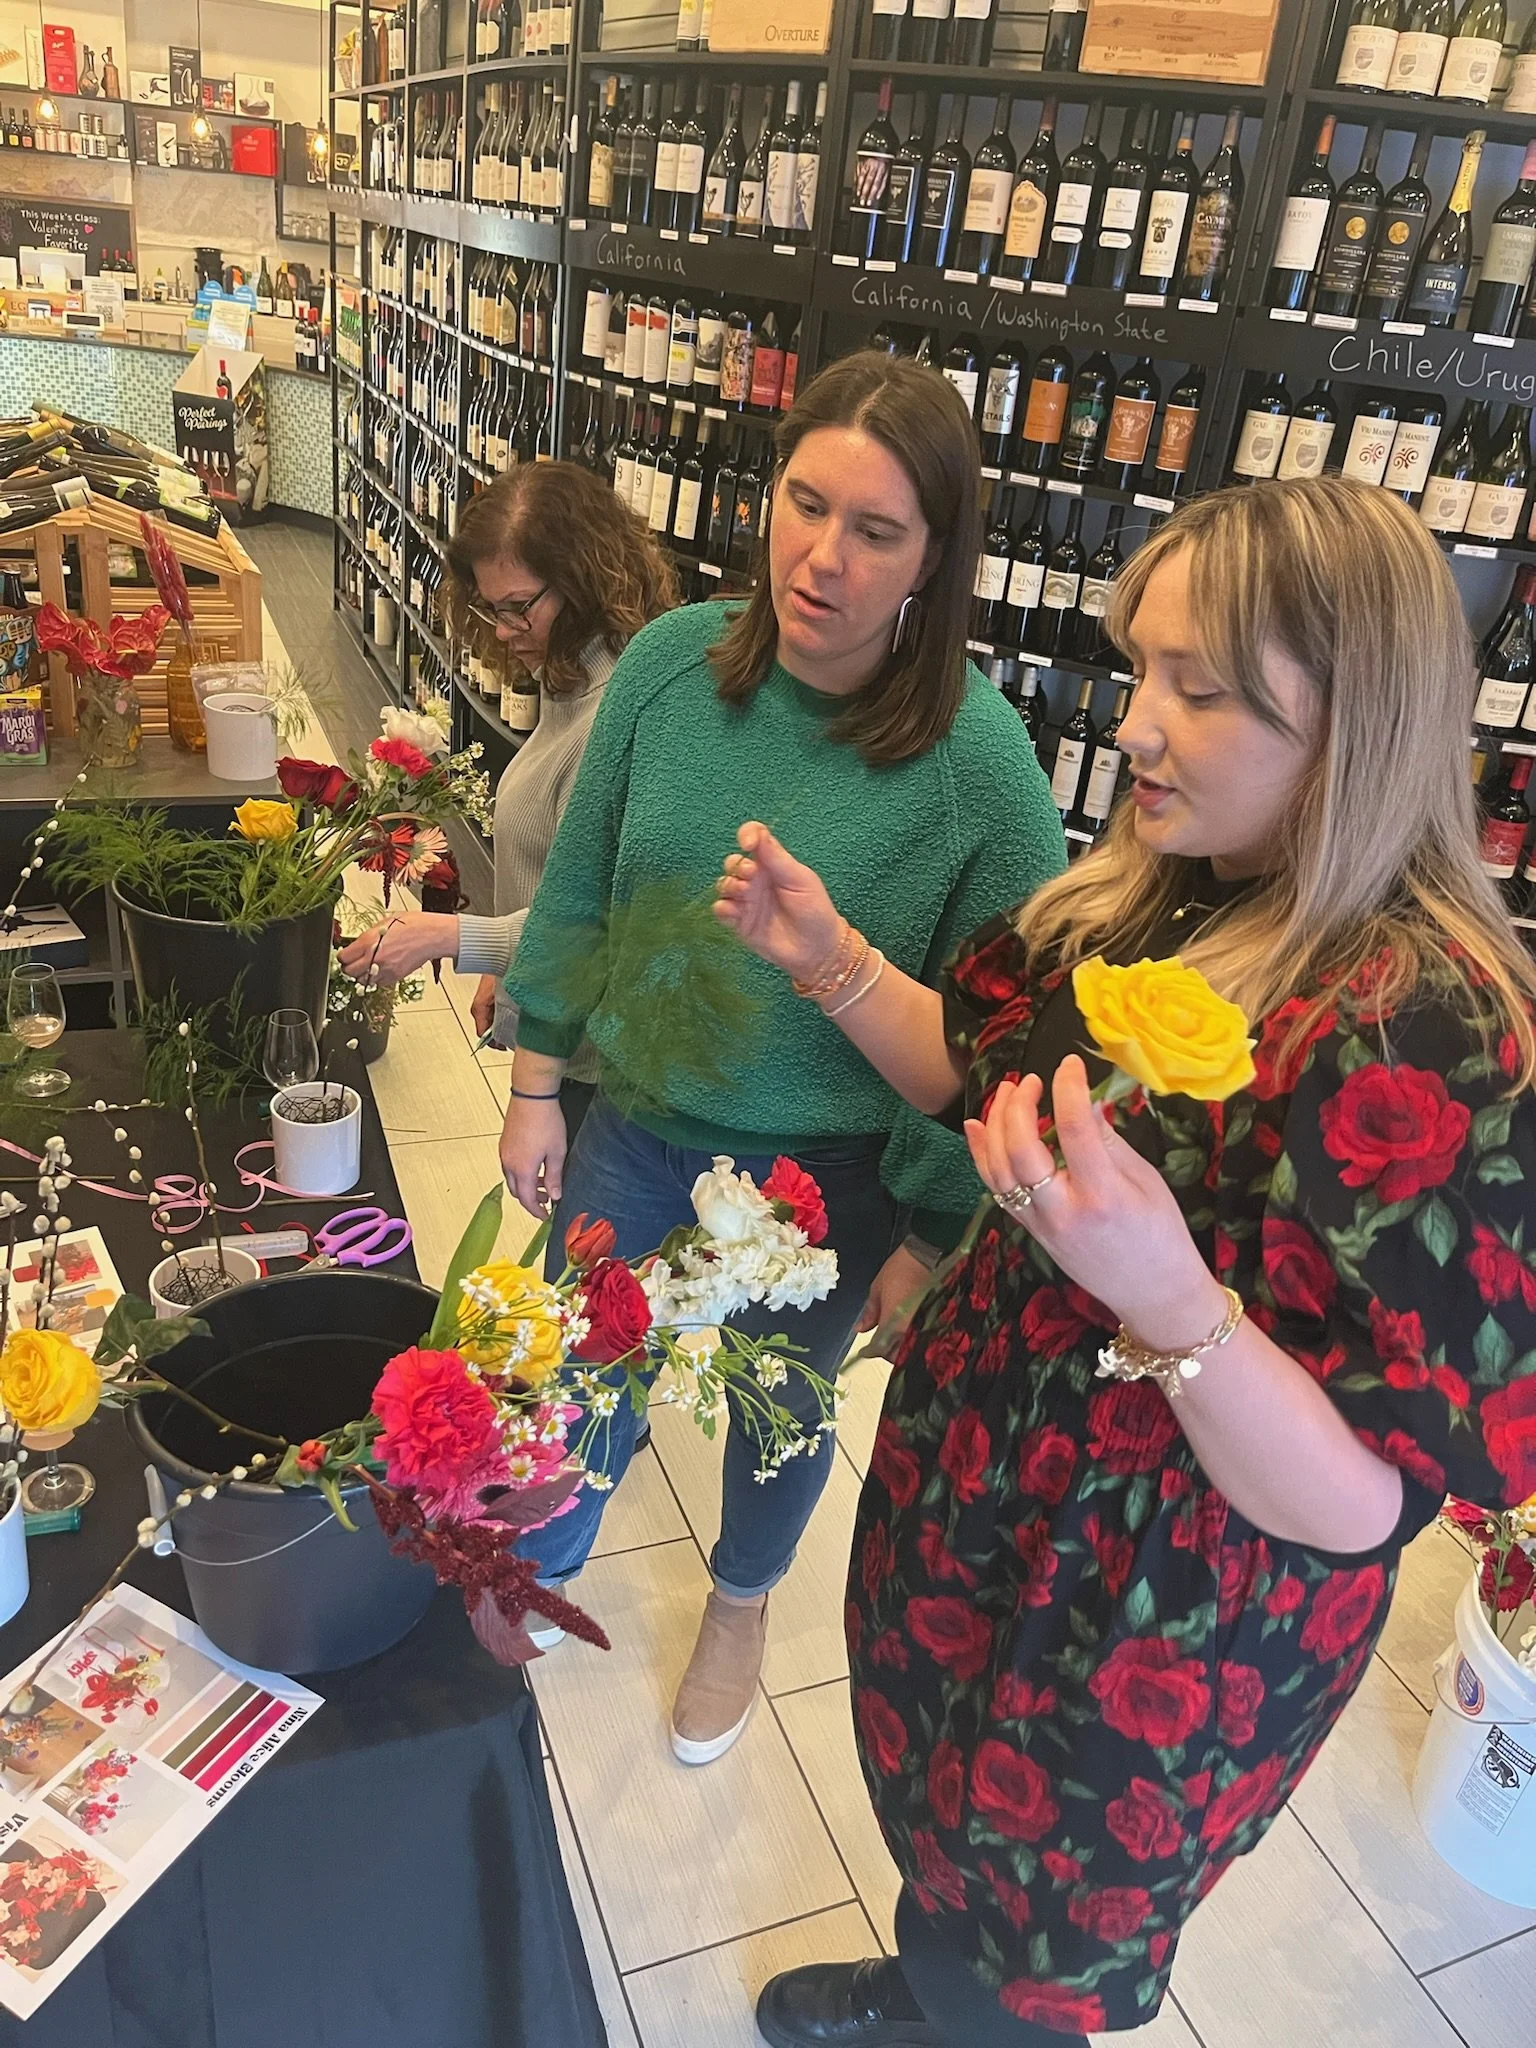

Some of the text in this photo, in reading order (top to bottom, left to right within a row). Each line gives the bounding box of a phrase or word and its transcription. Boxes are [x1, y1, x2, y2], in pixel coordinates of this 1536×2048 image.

[764, 25, 820, 42] OVERTURE
[20, 209, 101, 224] This Week's Class:
[29, 220, 79, 236] Valentine's
[44, 234, 89, 251] Favorites
[596, 233, 687, 277] California
[1425, 277, 1457, 292] INTENSO
[851, 276, 973, 320] California
[1113, 312, 1169, 344] State
[178, 406, 216, 421] Perfect
[185, 416, 228, 432] Pairings
[1013, 575, 1040, 588] ARING
[0, 715, 35, 734] MARDI
[6, 727, 35, 745] GRAS
[67, 1650, 98, 1679] SPICY
[205, 1707, 308, 1808] Nina Alice Blooms
[0, 1812, 30, 1846] Vis
